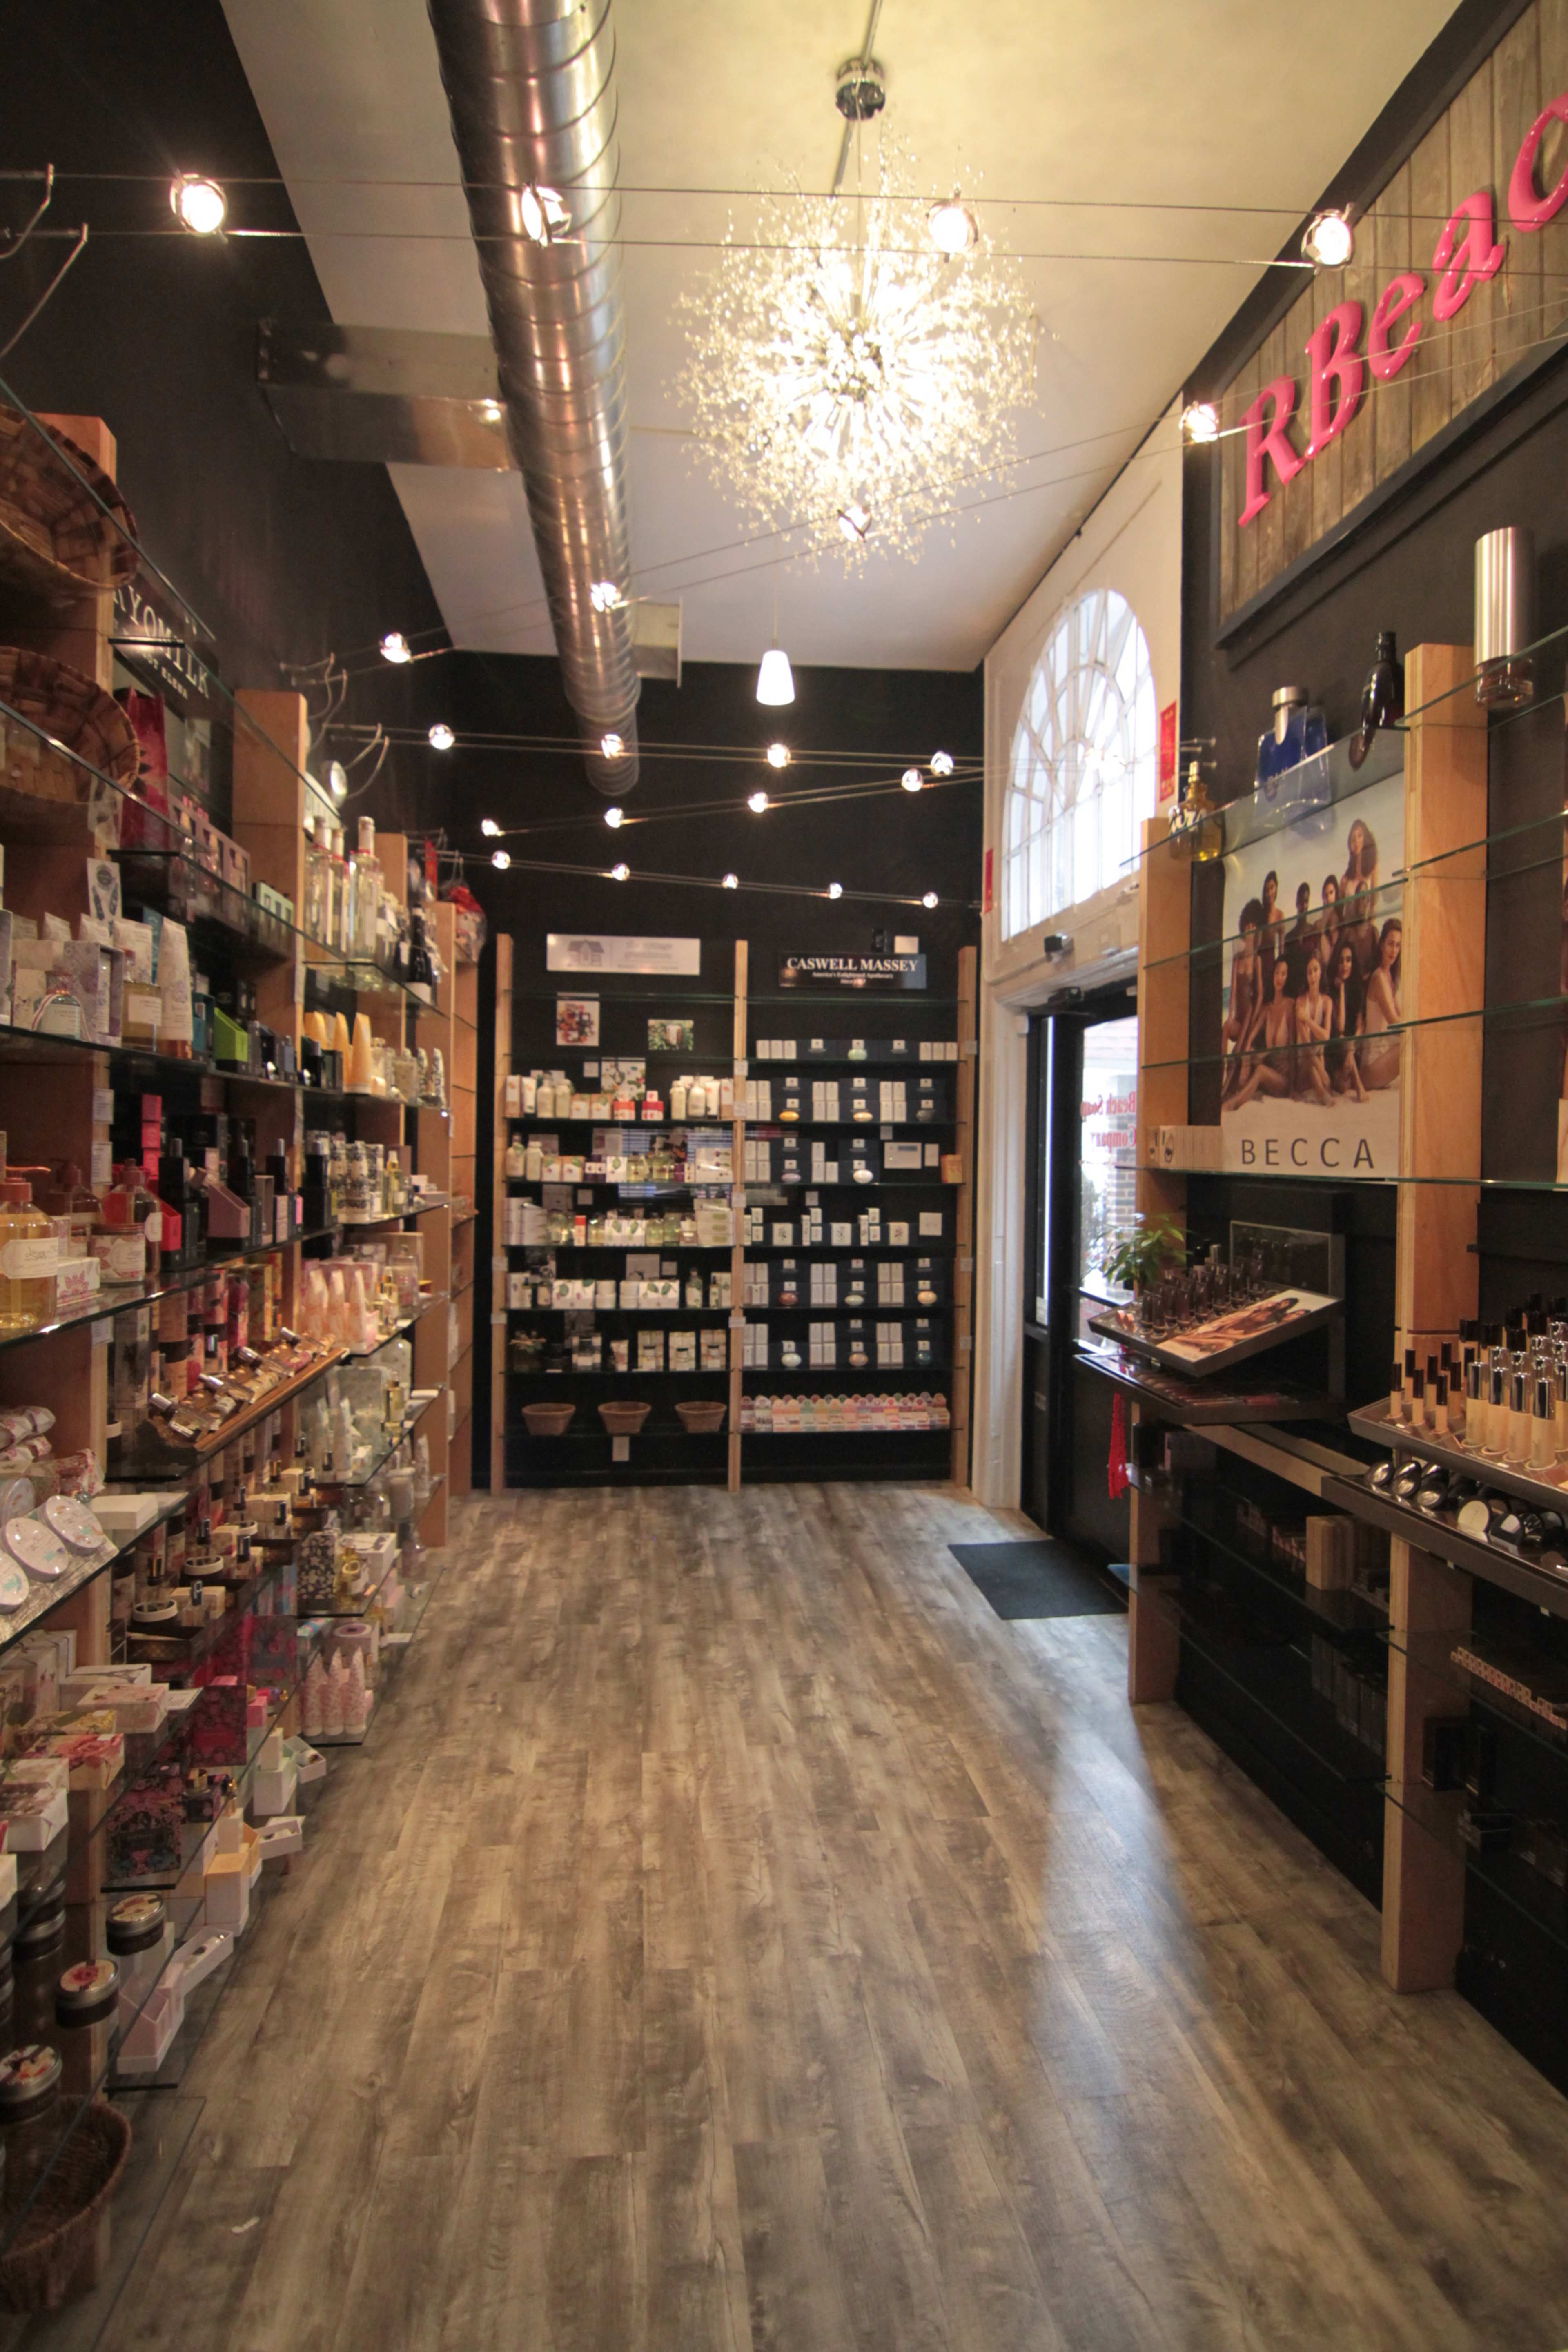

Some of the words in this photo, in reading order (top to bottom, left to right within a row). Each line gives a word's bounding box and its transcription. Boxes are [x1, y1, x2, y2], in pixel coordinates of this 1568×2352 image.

[787, 957, 858, 971] CASWELL
[860, 958, 918, 972] MASSEY
[1241, 1137, 1375, 1169] BECCA
